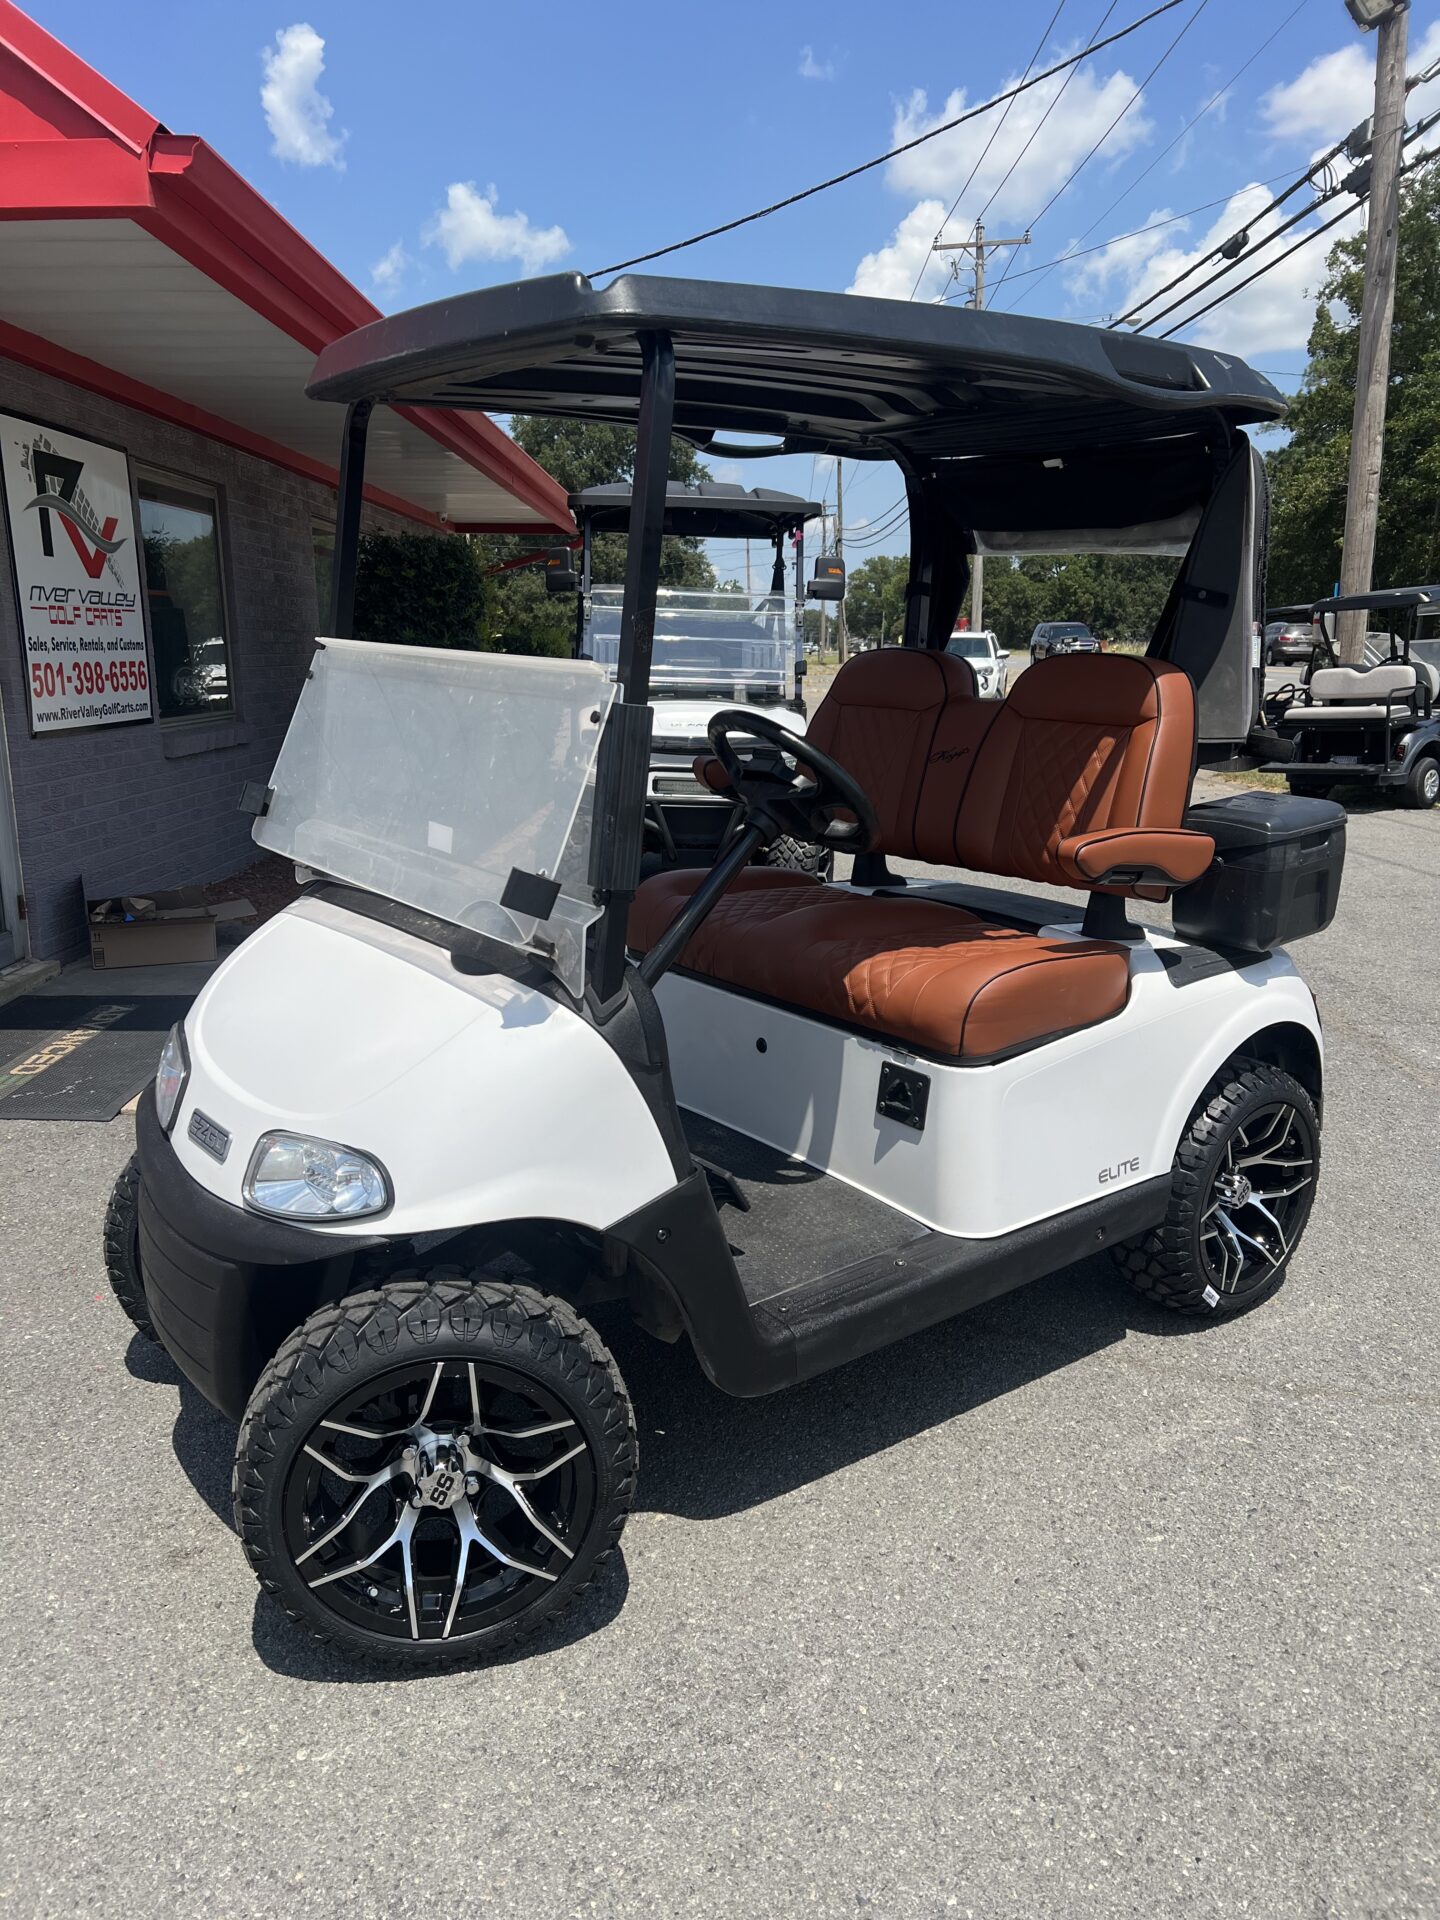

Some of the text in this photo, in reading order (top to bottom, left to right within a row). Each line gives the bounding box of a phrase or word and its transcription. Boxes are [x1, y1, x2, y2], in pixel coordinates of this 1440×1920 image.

[48, 605, 123, 627] GOLF CARTS
[28, 636, 144, 654] Sales, Service, Rentals, and Customs
[31, 660, 148, 699] 501-398-6556
[36, 702, 149, 723] www.RiverValleyGolfCarts.com
[1098, 1156, 1140, 1184] ELITE
[429, 1472, 455, 1506] SS
